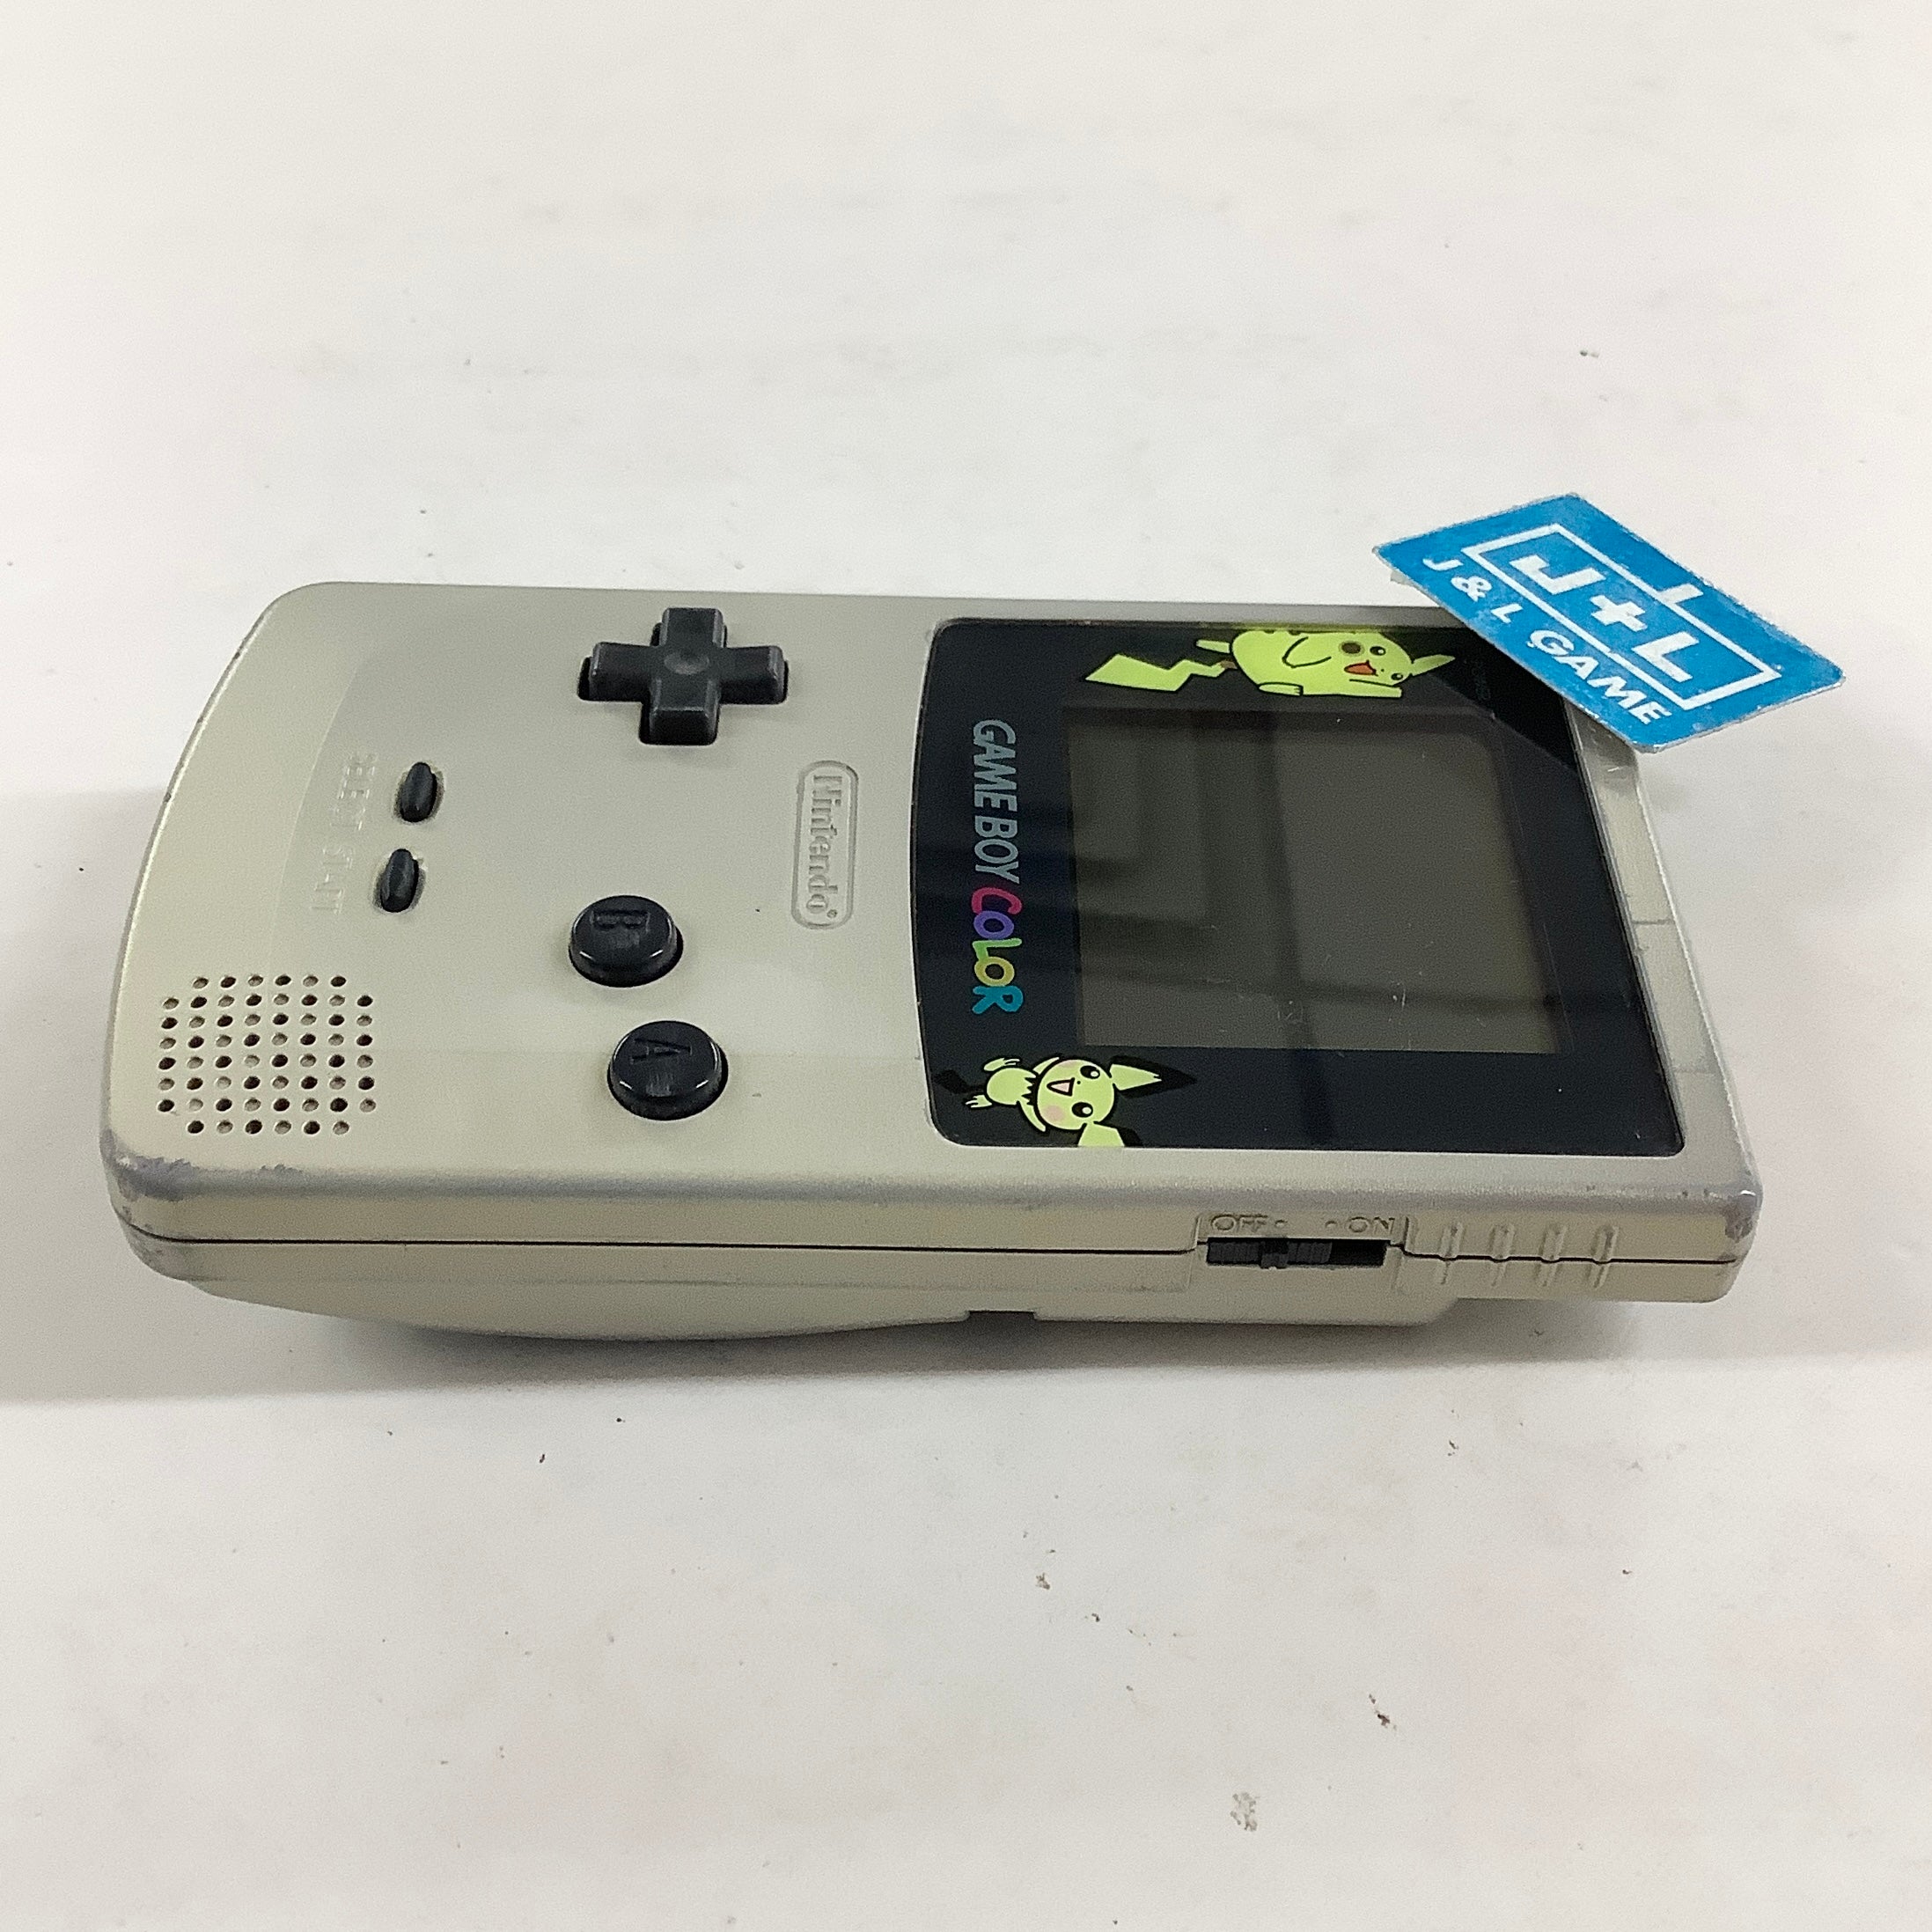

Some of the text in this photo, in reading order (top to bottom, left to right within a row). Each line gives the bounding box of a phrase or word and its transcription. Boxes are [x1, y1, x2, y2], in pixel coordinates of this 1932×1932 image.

[1422, 556, 1672, 725] J & L GAME
[1510, 554, 1700, 683] J+L
[971, 719, 1024, 1015] GAME BOY COLOR
[589, 909, 651, 933] B
[631, 1037, 693, 1064] A
[1211, 1213, 1396, 1234] OFF ON
